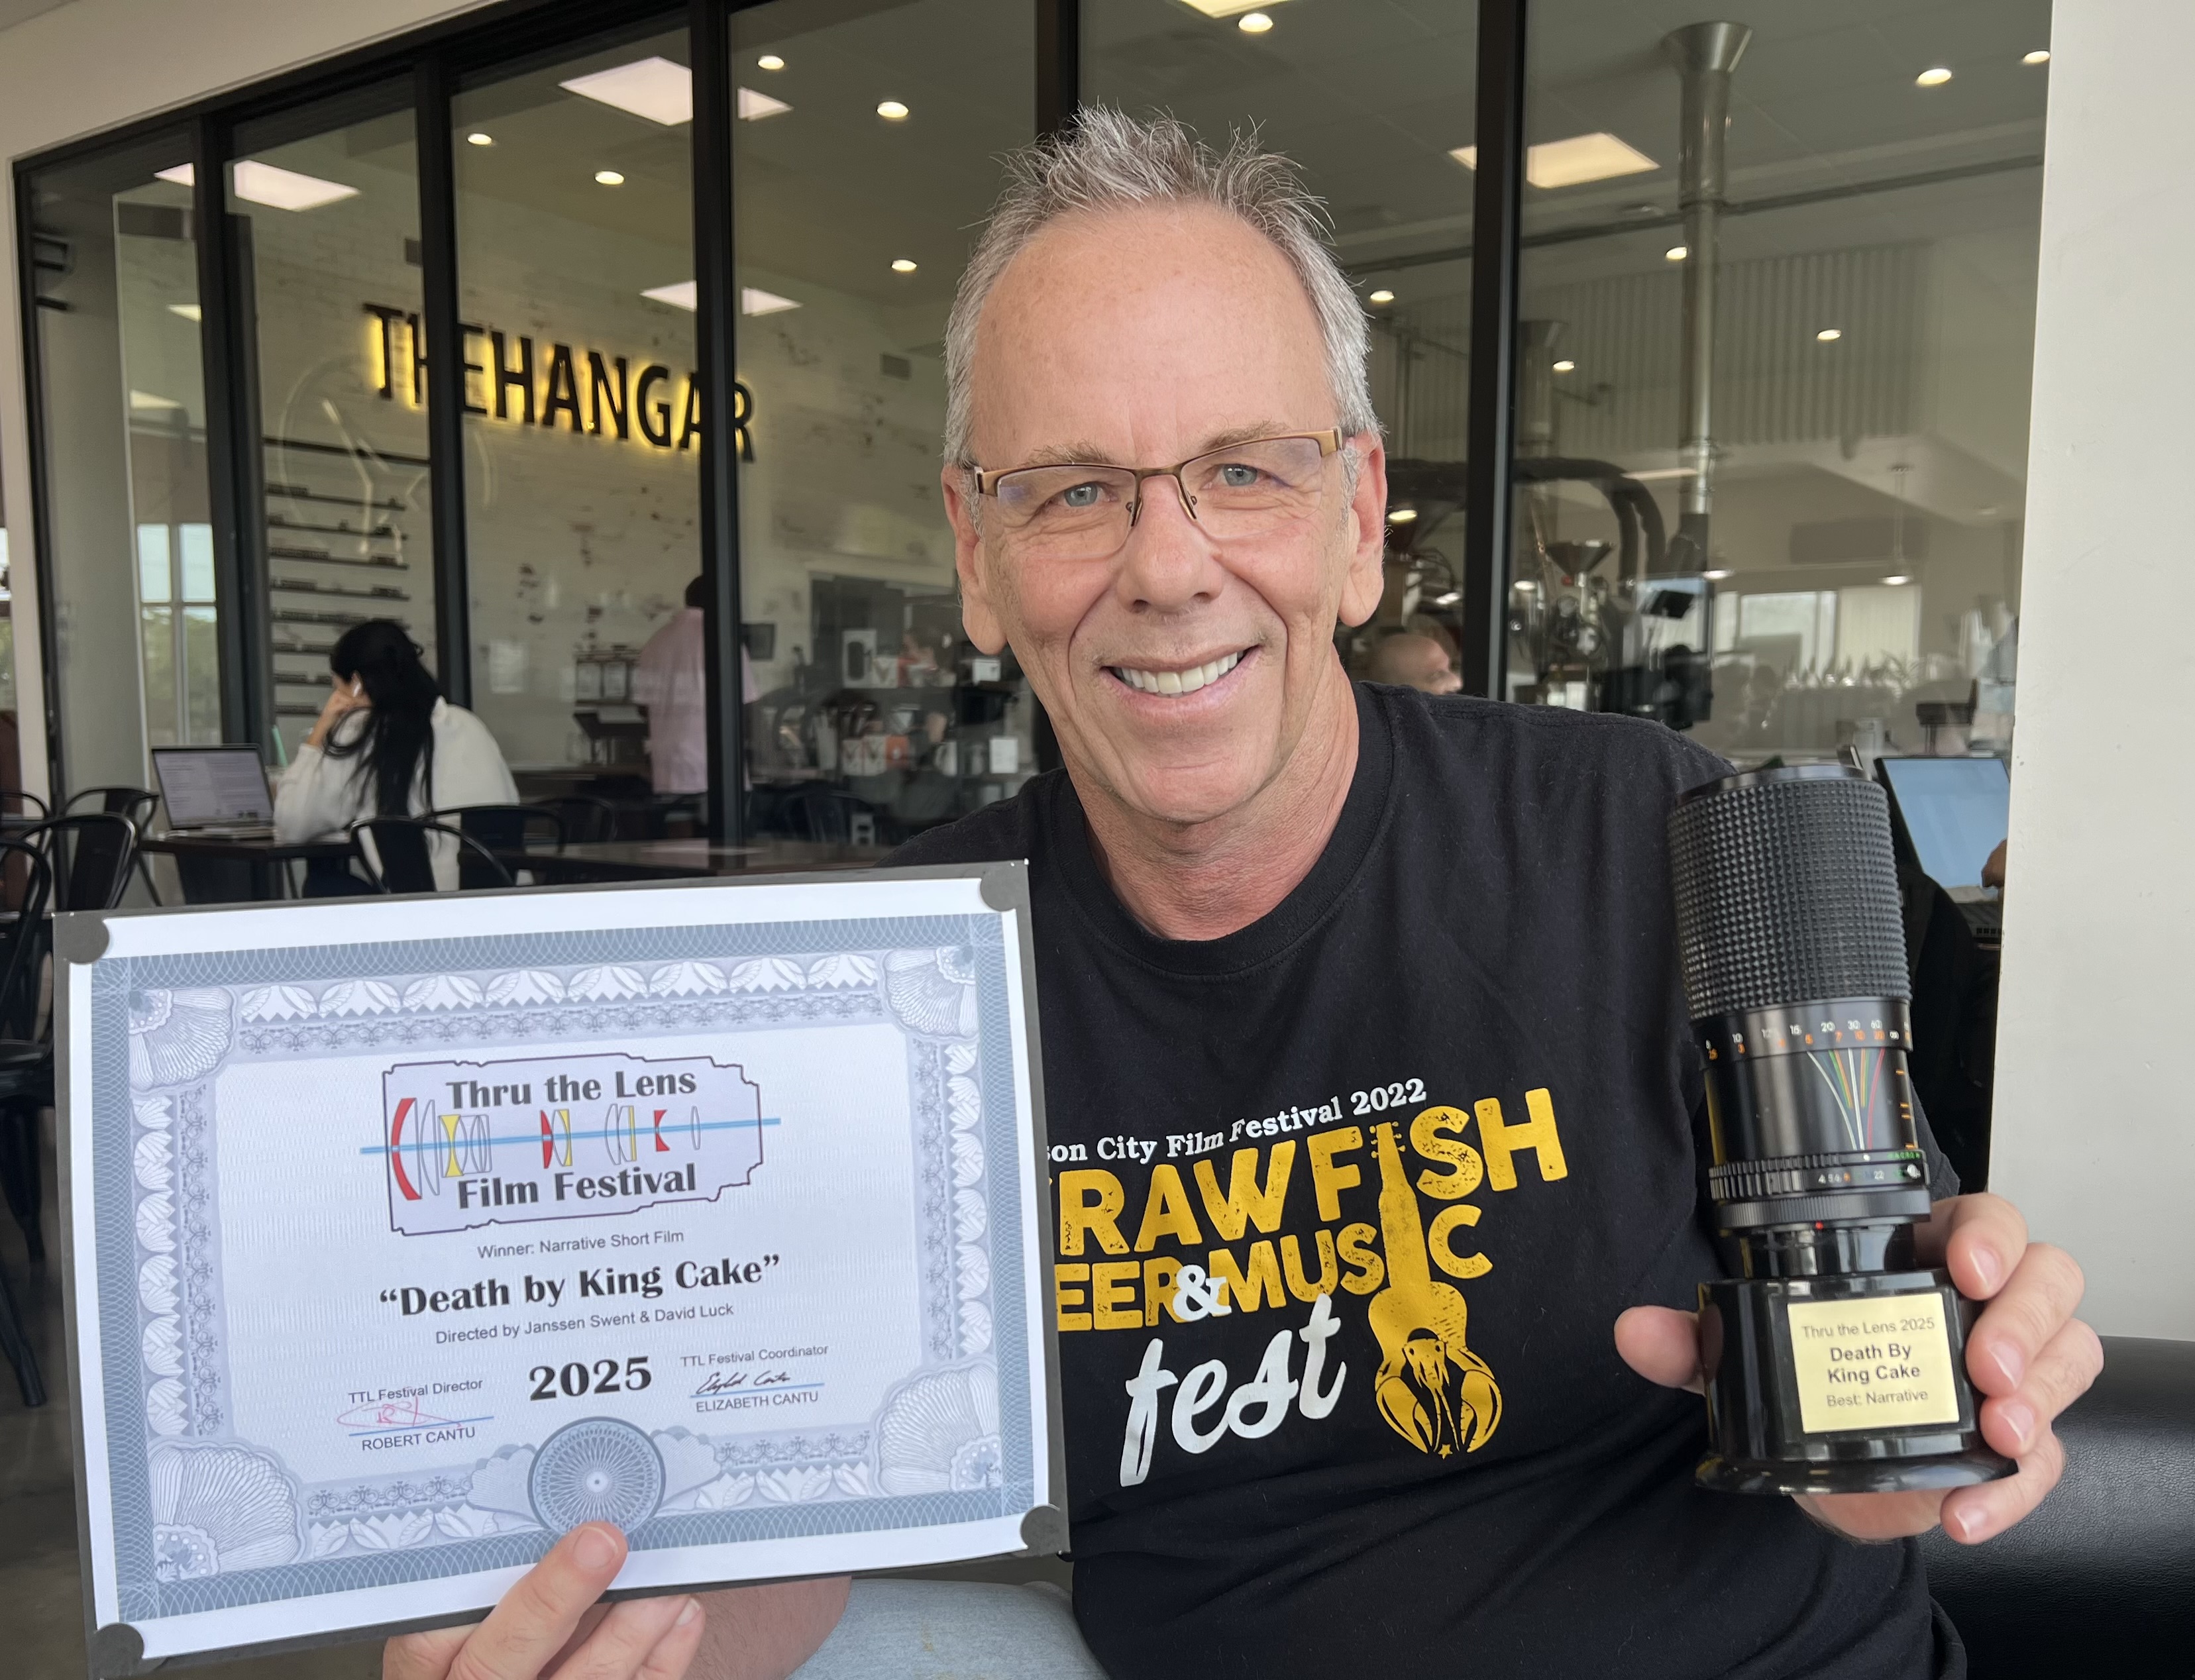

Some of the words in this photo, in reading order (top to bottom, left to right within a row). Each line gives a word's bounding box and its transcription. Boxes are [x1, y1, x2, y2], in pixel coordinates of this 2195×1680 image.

[1821, 1020, 1836, 1033] 20
[1847, 1020, 1861, 1031] 30
[446, 1081, 531, 1109] Thru
[546, 1075, 602, 1104] the
[616, 1070, 697, 1098] Lens
[1097, 1135, 1157, 1165] City
[1166, 1131, 1224, 1158] Film
[1229, 1096, 1342, 1143] Festival
[1350, 1078, 1427, 1116] 2022
[458, 1175, 539, 1209] Film
[555, 1163, 696, 1200] Festival
[1049, 1087, 1568, 1256] RAWFISH
[477, 1243, 535, 1259] Winner:
[539, 1237, 606, 1254] Narrative
[611, 1234, 651, 1247] Short
[654, 1230, 684, 1243] Film
[524, 1275, 566, 1307] by
[579, 1266, 664, 1298] King
[1172, 1265, 1232, 1322] &
[435, 1326, 499, 1345] Directed
[502, 1324, 520, 1337] by
[523, 1317, 586, 1336] Janssen
[590, 1312, 637, 1329] Swent
[640, 1311, 651, 1323] &
[654, 1306, 697, 1323] David
[700, 1303, 735, 1318] Luck
[1802, 1324, 1834, 1339] Thru
[1838, 1324, 1859, 1336] the
[1863, 1321, 1897, 1334] Lens
[1900, 1317, 1935, 1331] 2025
[680, 1356, 706, 1367] TTL
[709, 1350, 755, 1365] Festival
[759, 1345, 829, 1360] Coordinator
[1830, 1345, 1882, 1362] Death
[1888, 1342, 1912, 1360] By
[529, 1355, 652, 1402] 2025
[1827, 1367, 1870, 1385] King
[1876, 1363, 1921, 1380] Cake
[348, 1391, 376, 1404] TTL
[378, 1385, 428, 1401] Festival
[433, 1380, 484, 1395] Director
[696, 1396, 769, 1413] ELIZABETH
[773, 1391, 820, 1405] CANTU
[1120, 1293, 1347, 1487] fest
[1827, 1394, 1862, 1407] Best:
[1866, 1389, 1929, 1405] Narrative
[361, 1433, 422, 1451] ROBERT
[425, 1426, 476, 1444] CANTU
